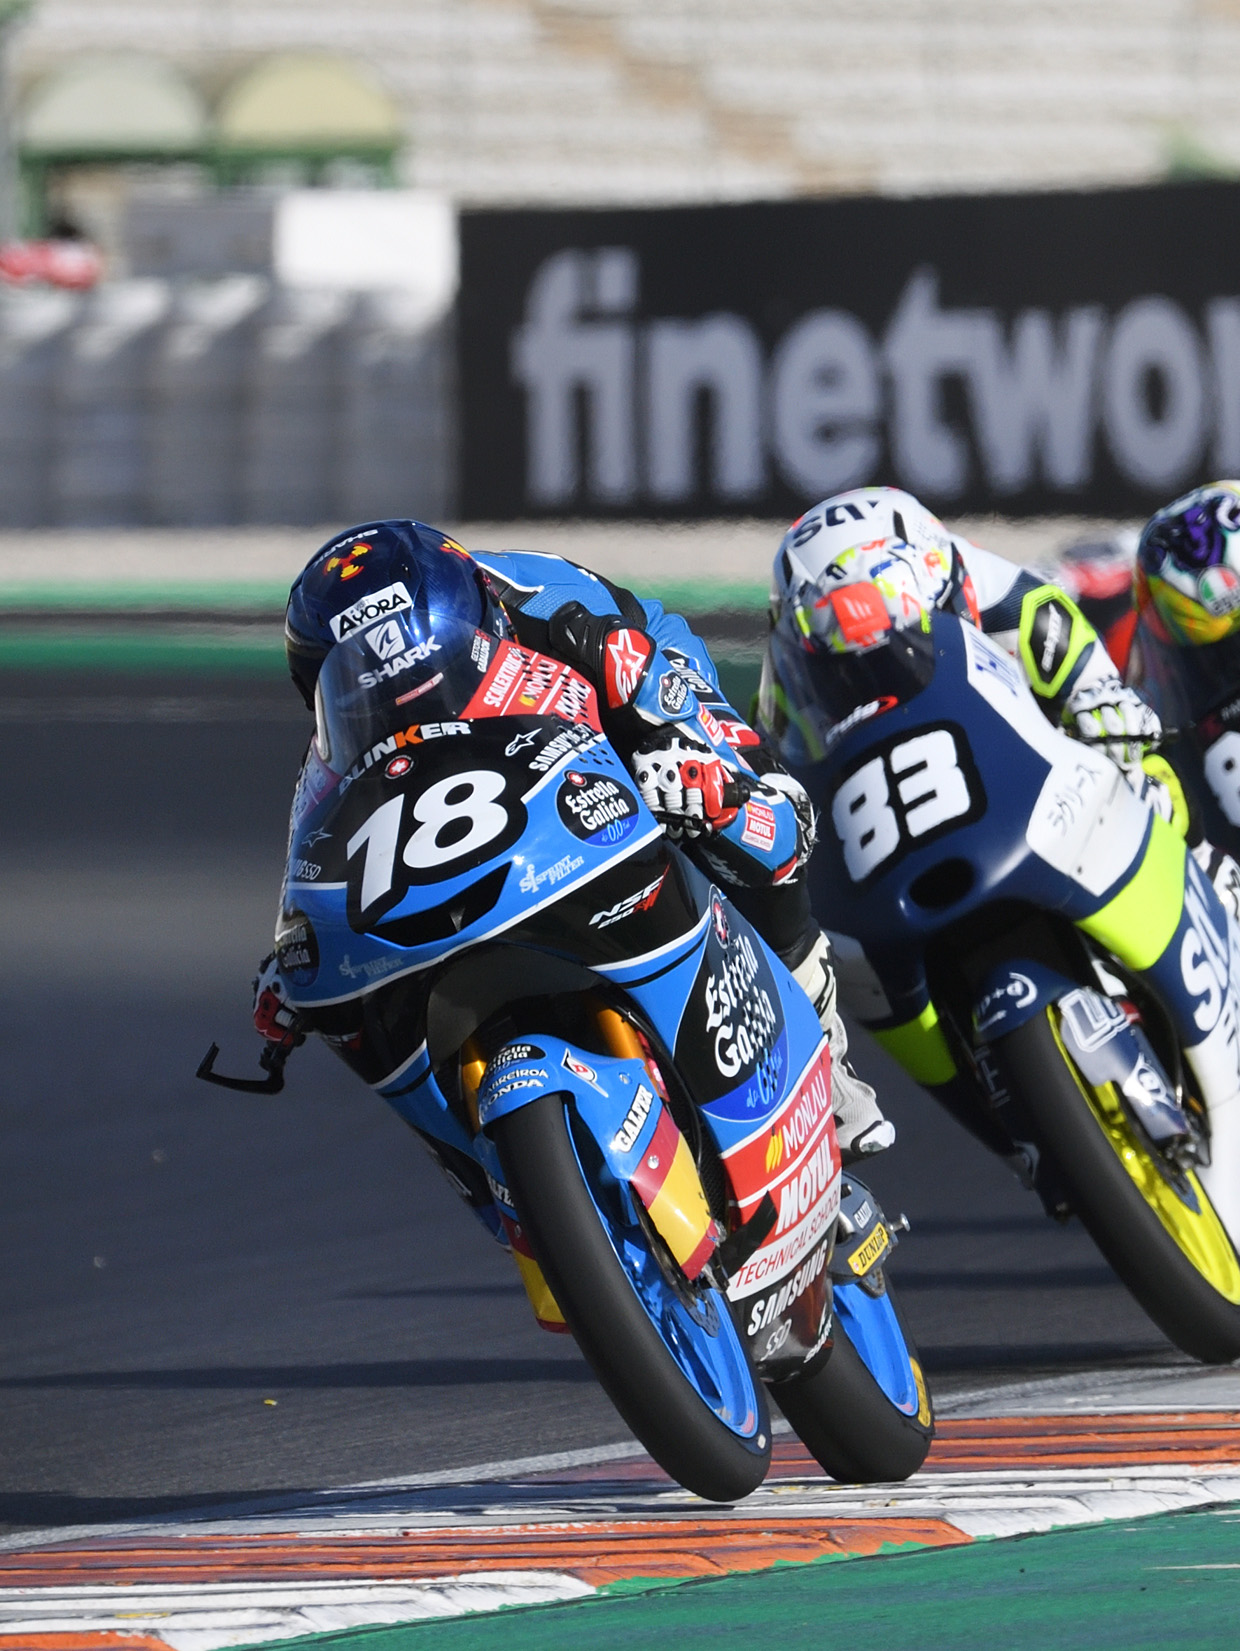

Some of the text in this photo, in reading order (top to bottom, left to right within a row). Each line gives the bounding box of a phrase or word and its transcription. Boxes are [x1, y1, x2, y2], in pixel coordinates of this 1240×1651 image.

[338, 592, 408, 639] AYORA
[357, 634, 442, 690] SHARK
[338, 721, 472, 797] BLINKER
[565, 780, 620, 815] Estrella
[579, 797, 630, 831] Galicia
[832, 729, 971, 883] 83
[346, 769, 509, 914] 18
[588, 875, 665, 926] NSF
[705, 933, 760, 1033] Estrella
[487, 1079, 545, 1106] ONDA
[781, 1069, 829, 1159] MONLAU
[775, 1133, 835, 1236] MOTUL
[736, 1231, 809, 1288] TECHNICAL
[808, 1188, 840, 1240] SCHOOL
[858, 1229, 886, 1268] DUNLOP
[746, 1238, 829, 1337] SAMSUNG
[759, 1317, 793, 1362] SSD
